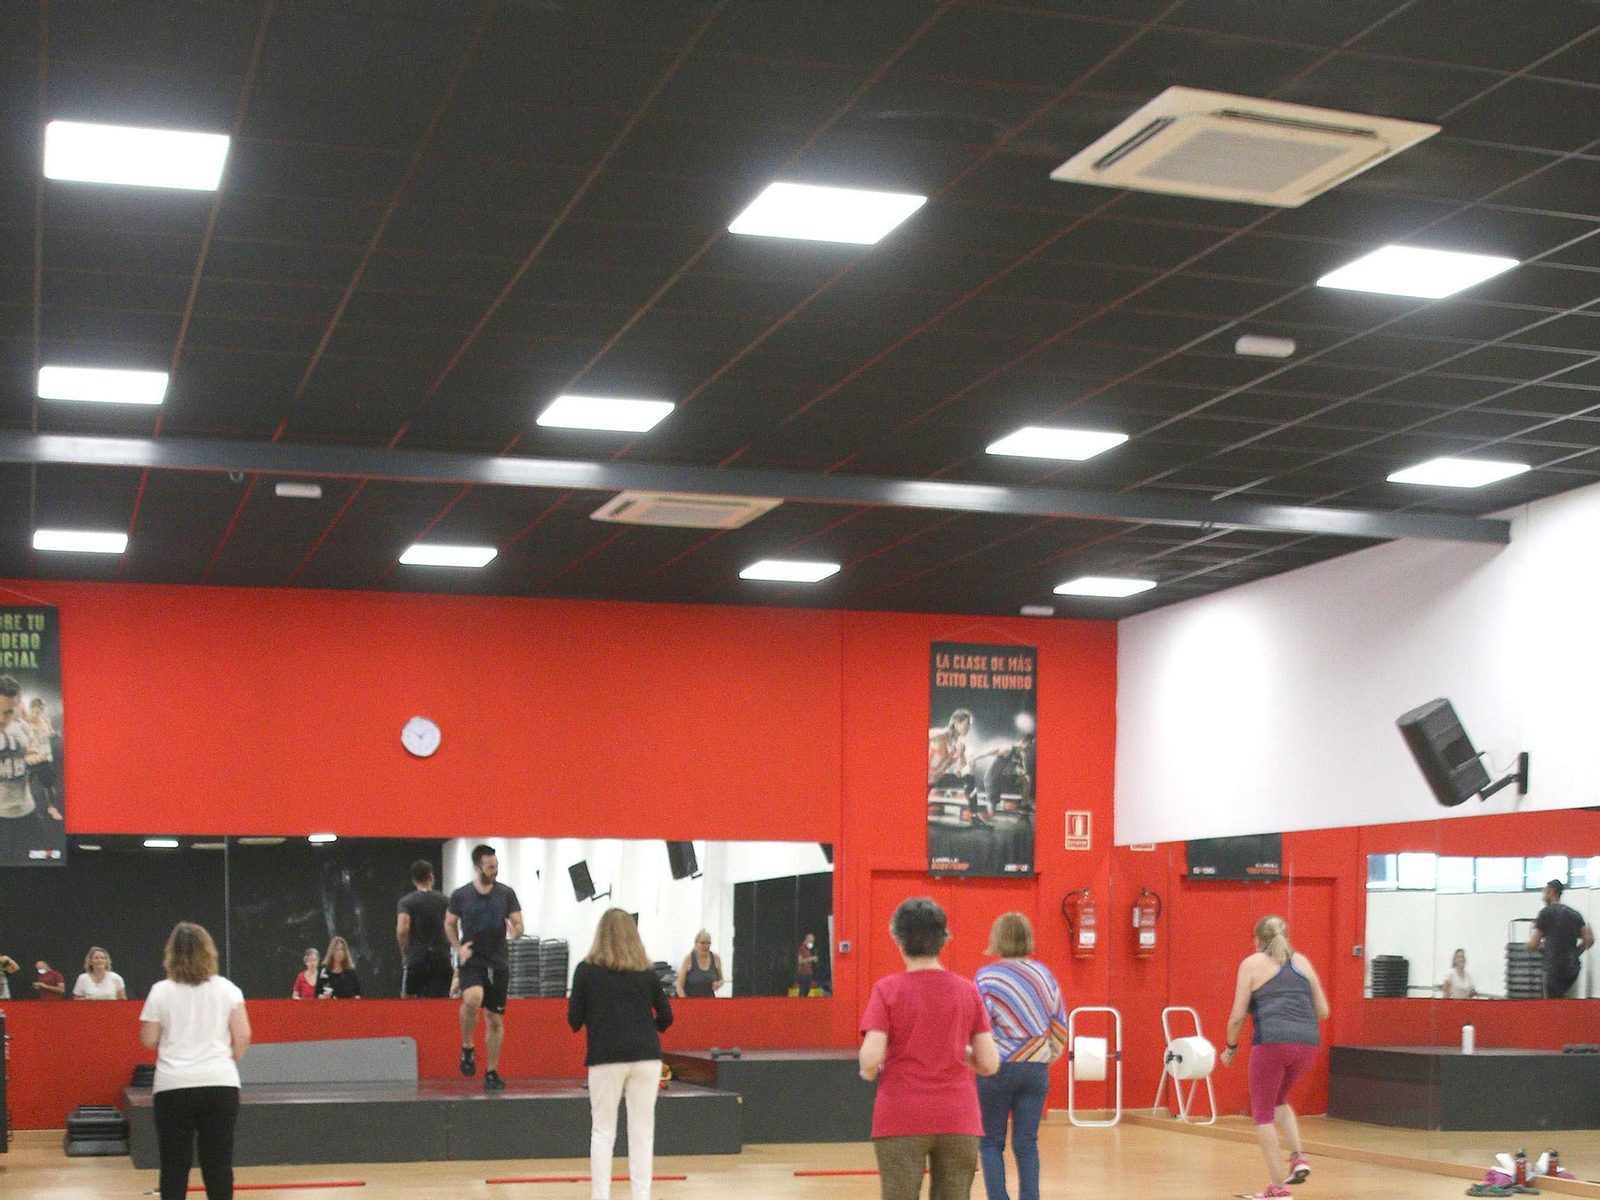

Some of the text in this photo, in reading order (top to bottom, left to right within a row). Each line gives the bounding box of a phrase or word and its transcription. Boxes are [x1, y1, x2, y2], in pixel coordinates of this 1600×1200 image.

[0, 613, 46, 631] RE TU
[0, 632, 41, 650] DERO
[936, 654, 1032, 672] LA CLASE DE MÁS
[936, 669, 1032, 690] ÉXITO DEL MUNDO
